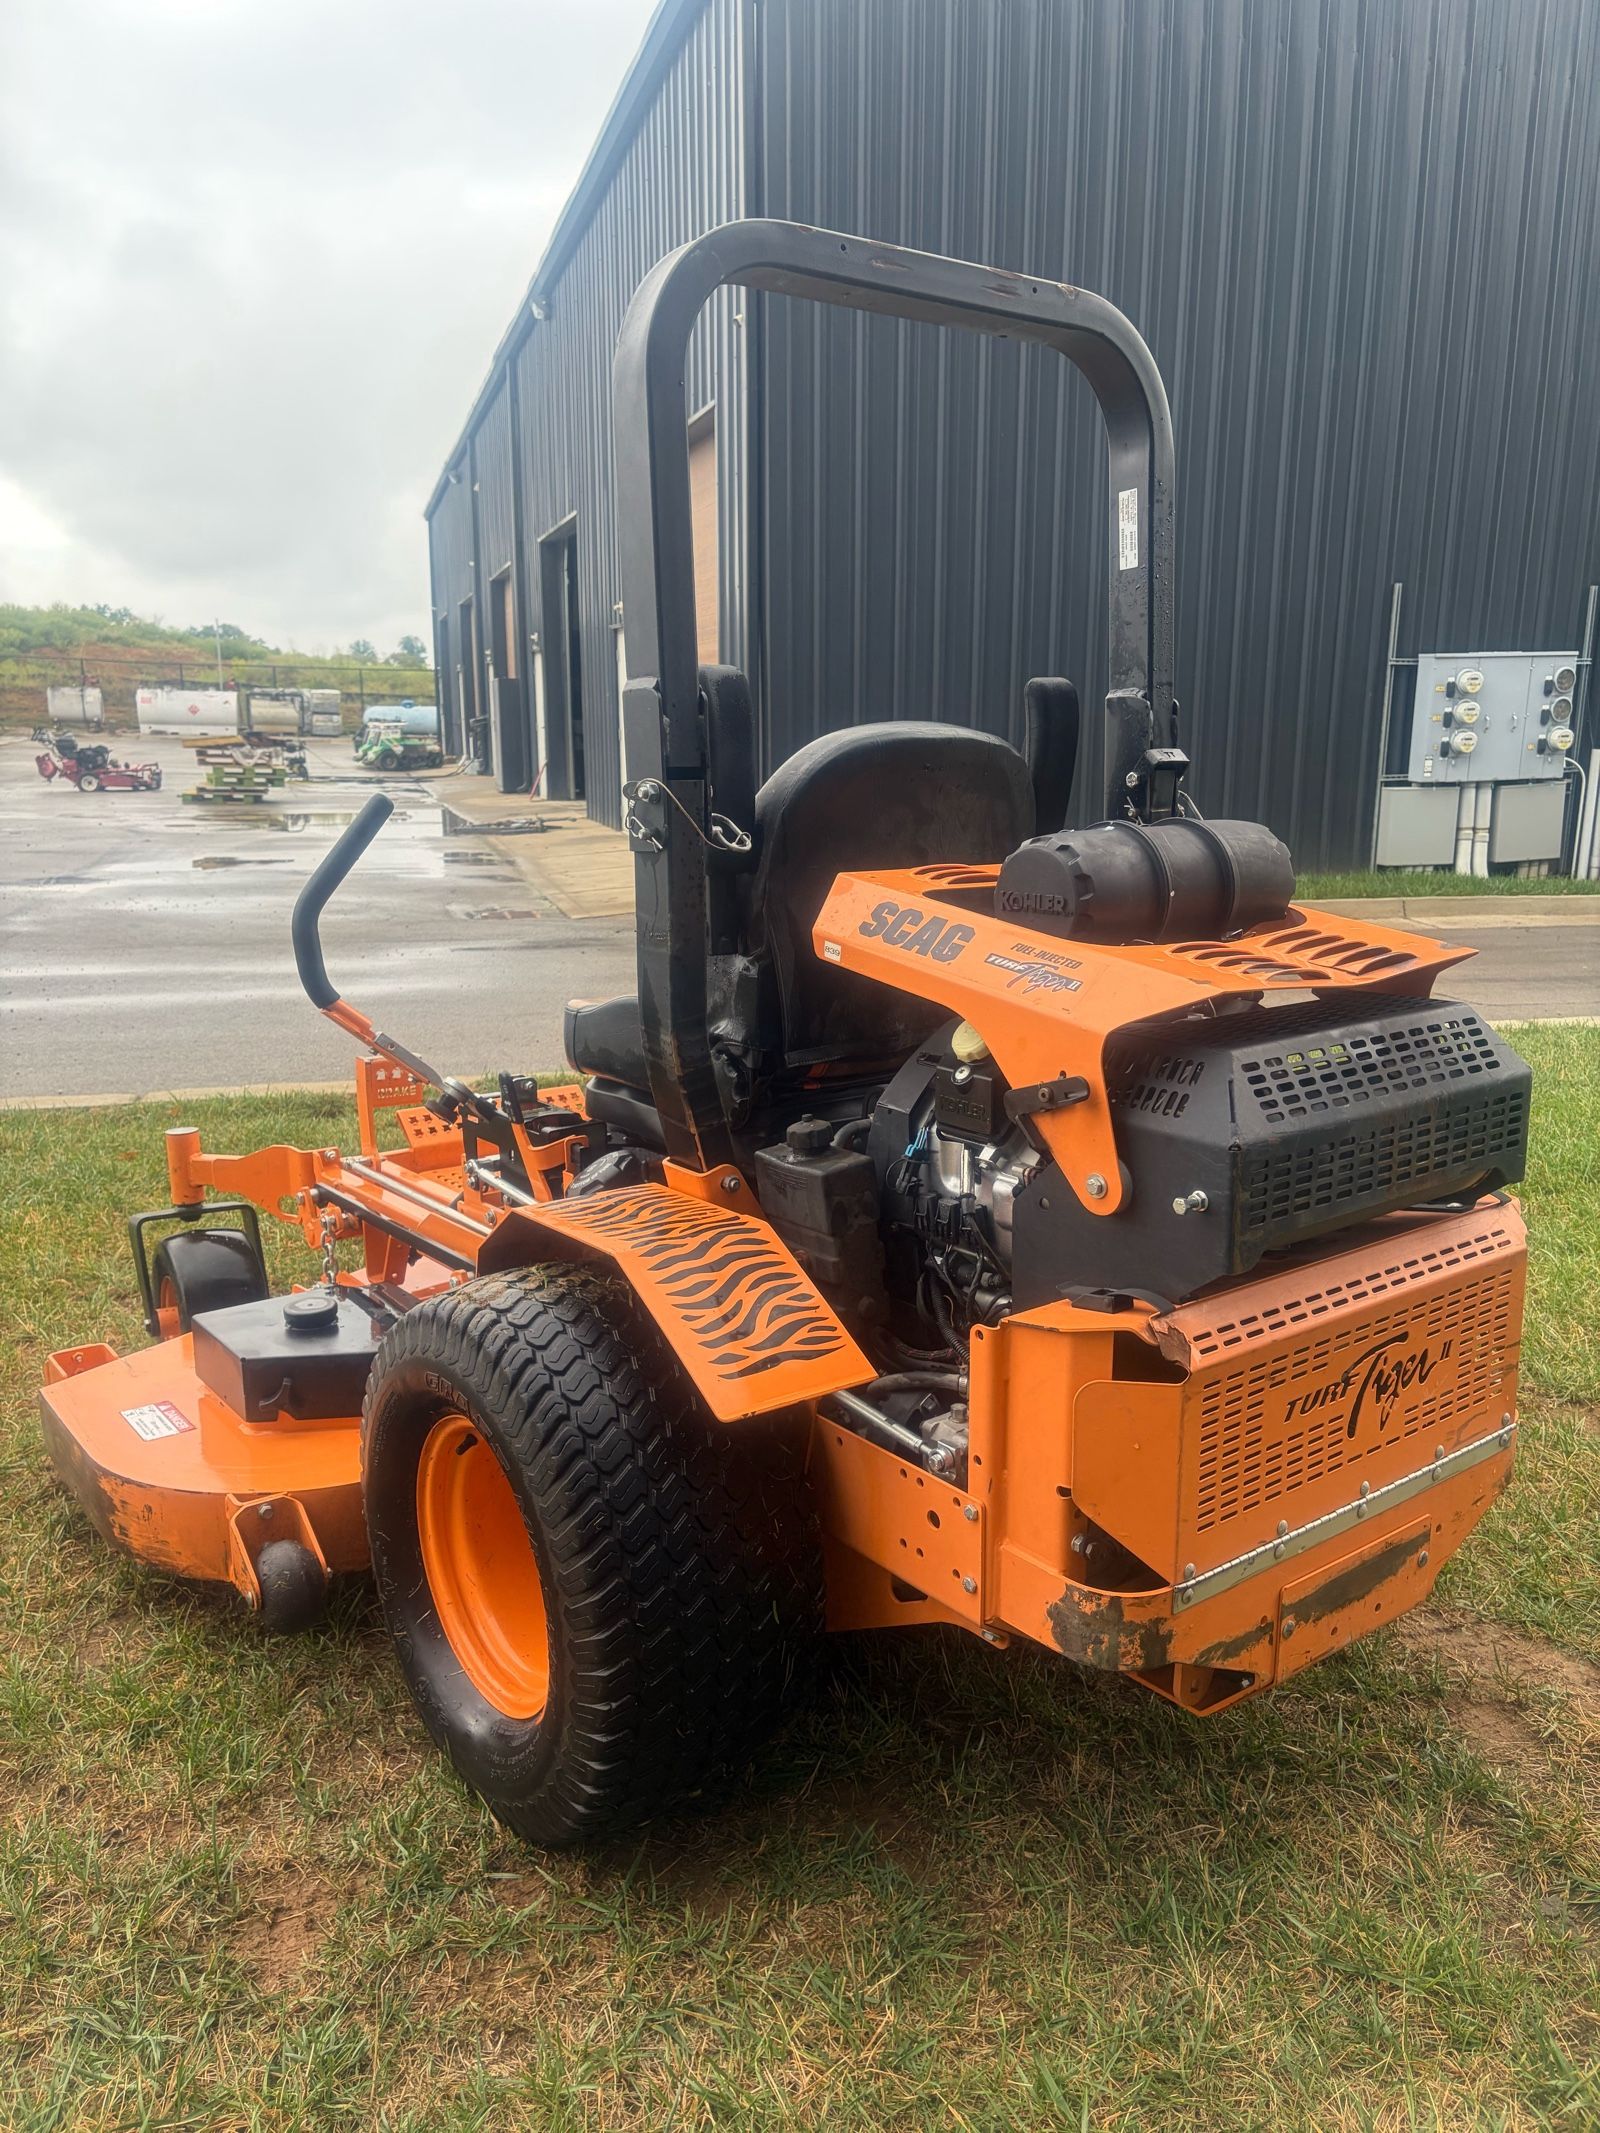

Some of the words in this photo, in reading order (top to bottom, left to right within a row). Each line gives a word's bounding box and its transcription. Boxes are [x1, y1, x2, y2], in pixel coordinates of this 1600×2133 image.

[999, 889, 1067, 913] KOHLER
[858, 901, 976, 963] SCAG
[1010, 943, 1083, 969] FUEL-INJECTED
[1283, 1372, 1359, 1423] TURF
[1344, 1331, 1437, 1440] Tiger
